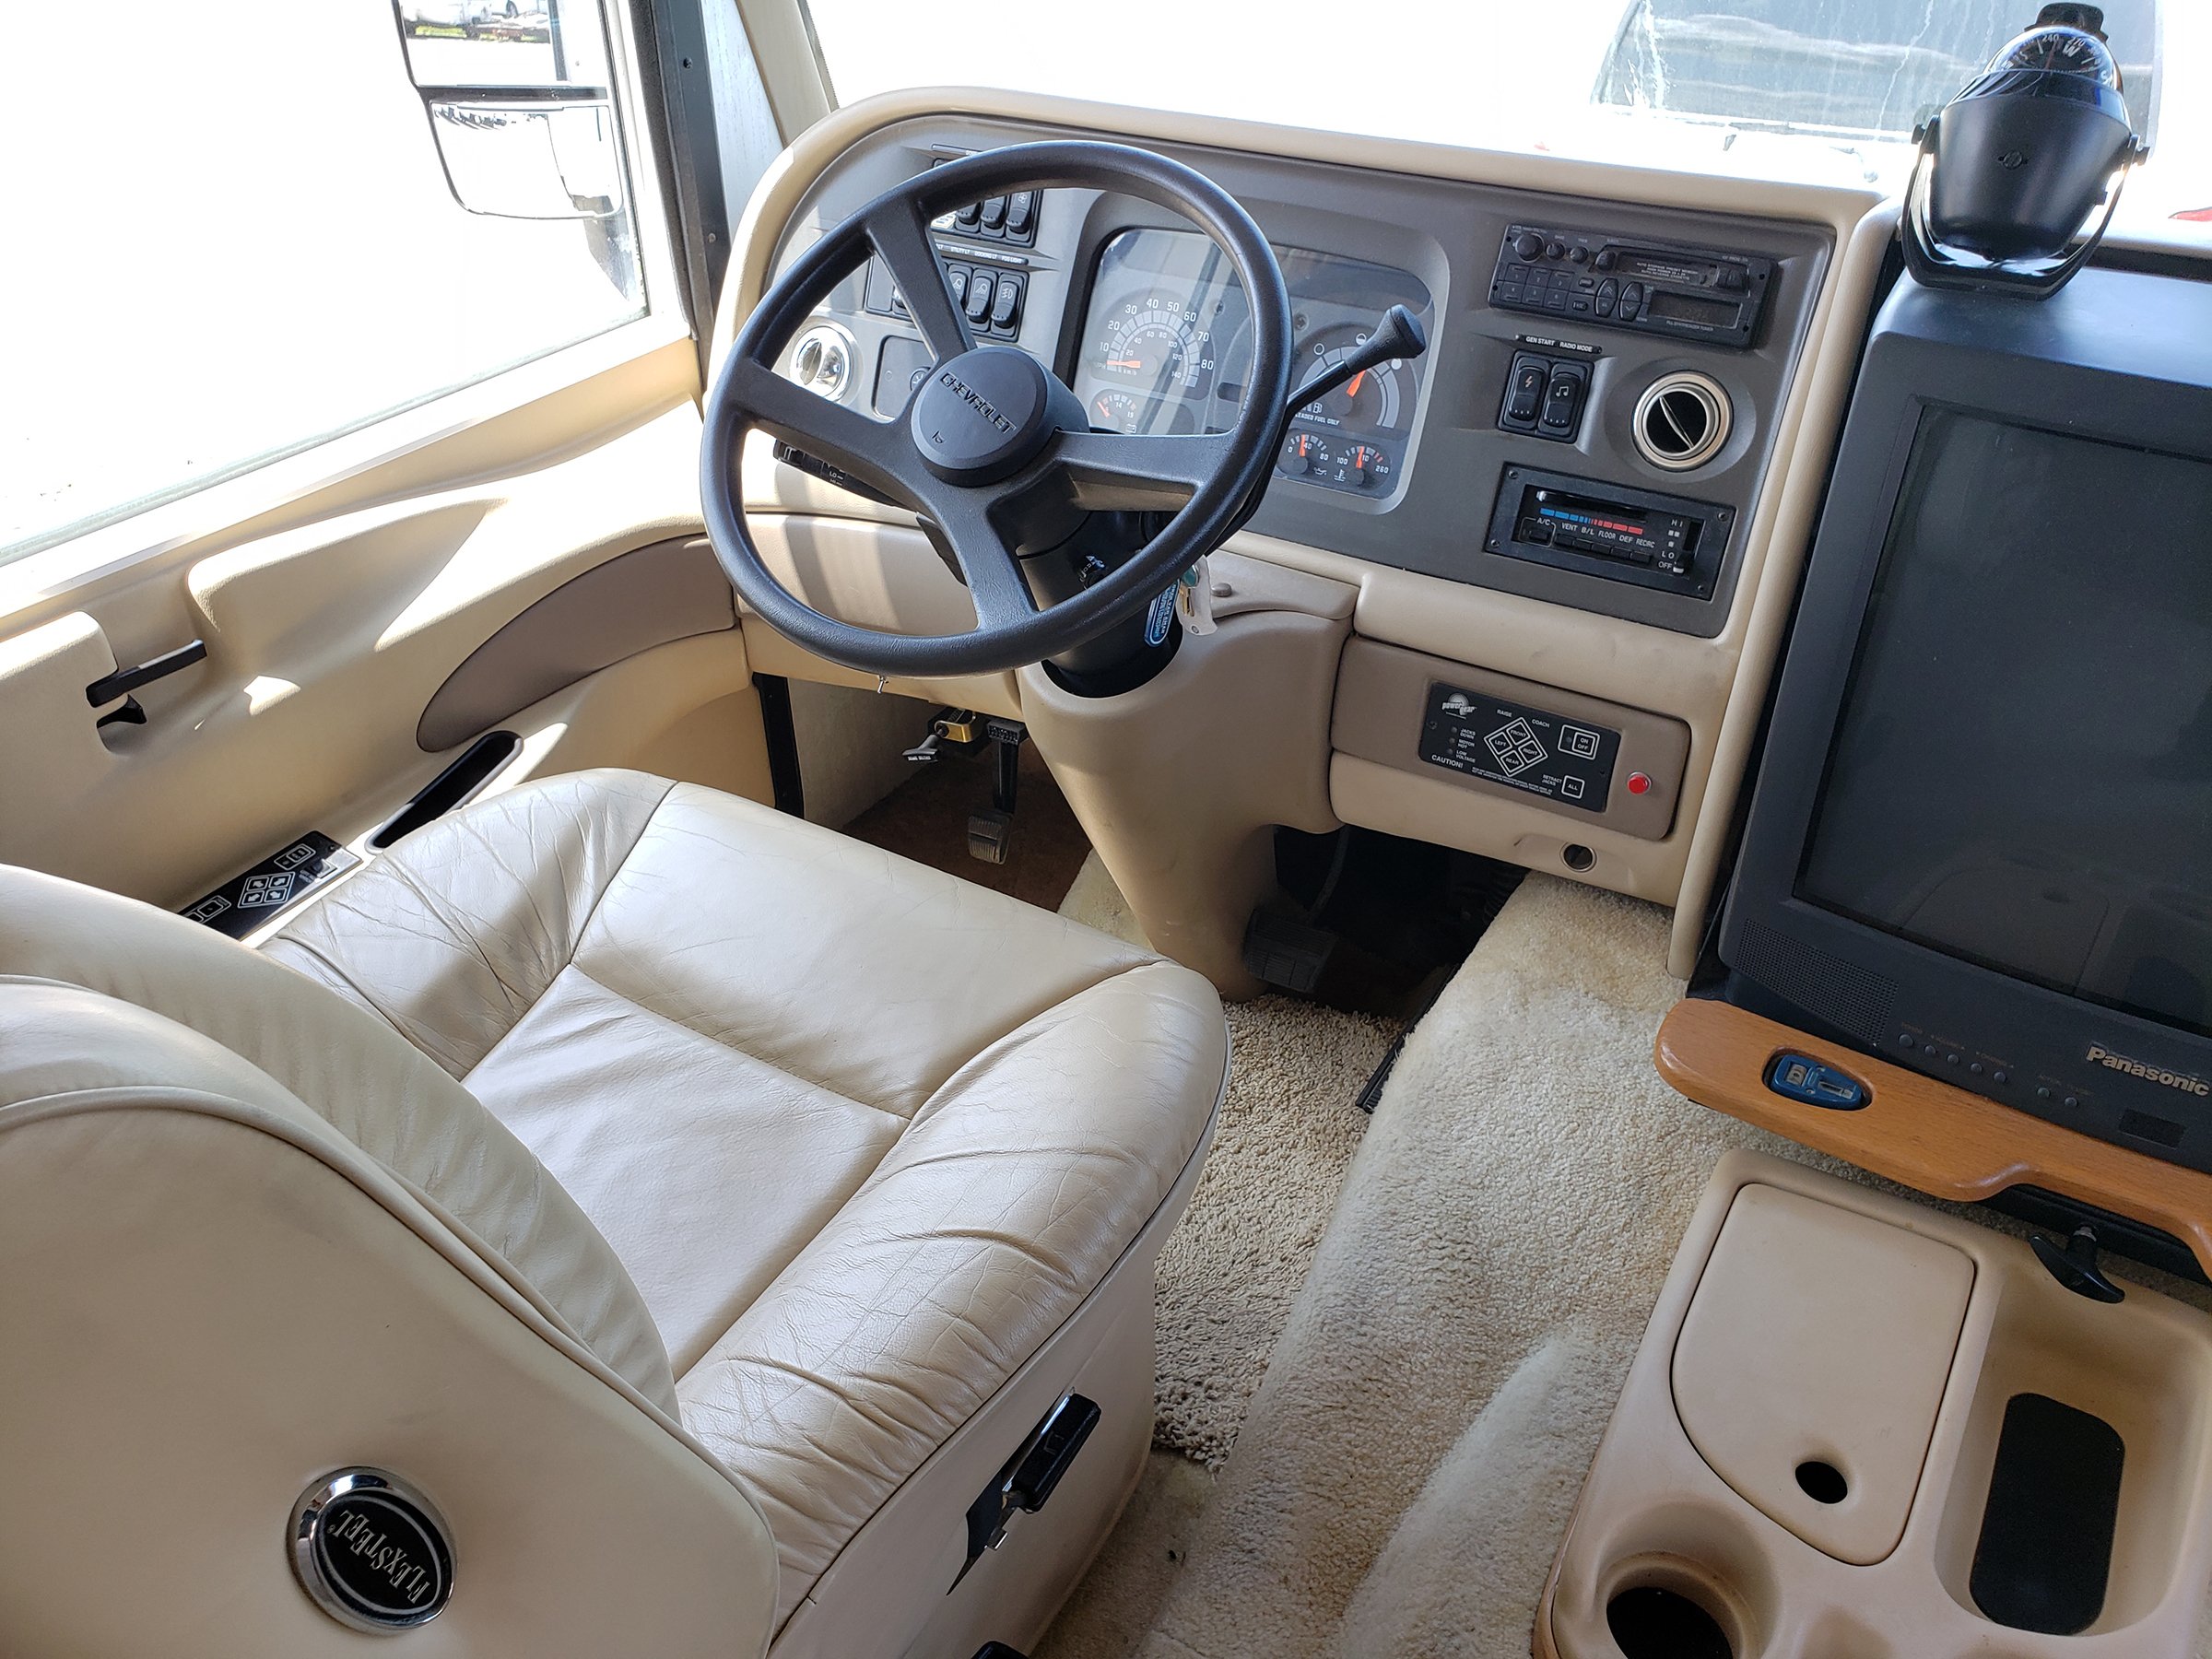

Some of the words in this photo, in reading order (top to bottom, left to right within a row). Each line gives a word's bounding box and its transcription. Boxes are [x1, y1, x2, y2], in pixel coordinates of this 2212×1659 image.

[2042, 34, 2059, 42] 240
[2063, 42, 2081, 57] W
[1147, 299, 1159, 309] 40
[1167, 301, 1179, 312] 50
[1125, 305, 1137, 314] 30
[1183, 312, 1196, 322] 60
[1108, 320, 1120, 330] 20
[1198, 332, 1209, 342] 70
[1100, 342, 1110, 351] 10
[1538, 338, 1556, 347] START
[1559, 341, 1576, 349] RADIO
[1577, 345, 1593, 353] MODE
[1201, 359, 1214, 370] 80
[940, 372, 1017, 434] CHEVROLET
[1319, 453, 1329, 461] 80
[1336, 456, 1348, 465] 100
[1537, 517, 1551, 526] A/C
[1561, 523, 1578, 532] VENT
[1581, 526, 1594, 535] B/L
[1598, 530, 1616, 540] FLOOR
[1619, 535, 1633, 543] DEF
[1636, 538, 1655, 548] RECIRC
[1658, 560, 1672, 570] OFF
[1497, 709, 1512, 718] RAISE
[1531, 719, 1549, 728] COACH
[1510, 729, 1526, 737] FRONT
[1523, 747, 1538, 756] RIGHT
[1431, 754, 1464, 769] CAUTION!
[1505, 757, 1519, 765] REAR
[2086, 1045, 2210, 1097] Panasonic
[333, 1510, 430, 1604] FLEXSTEEL
